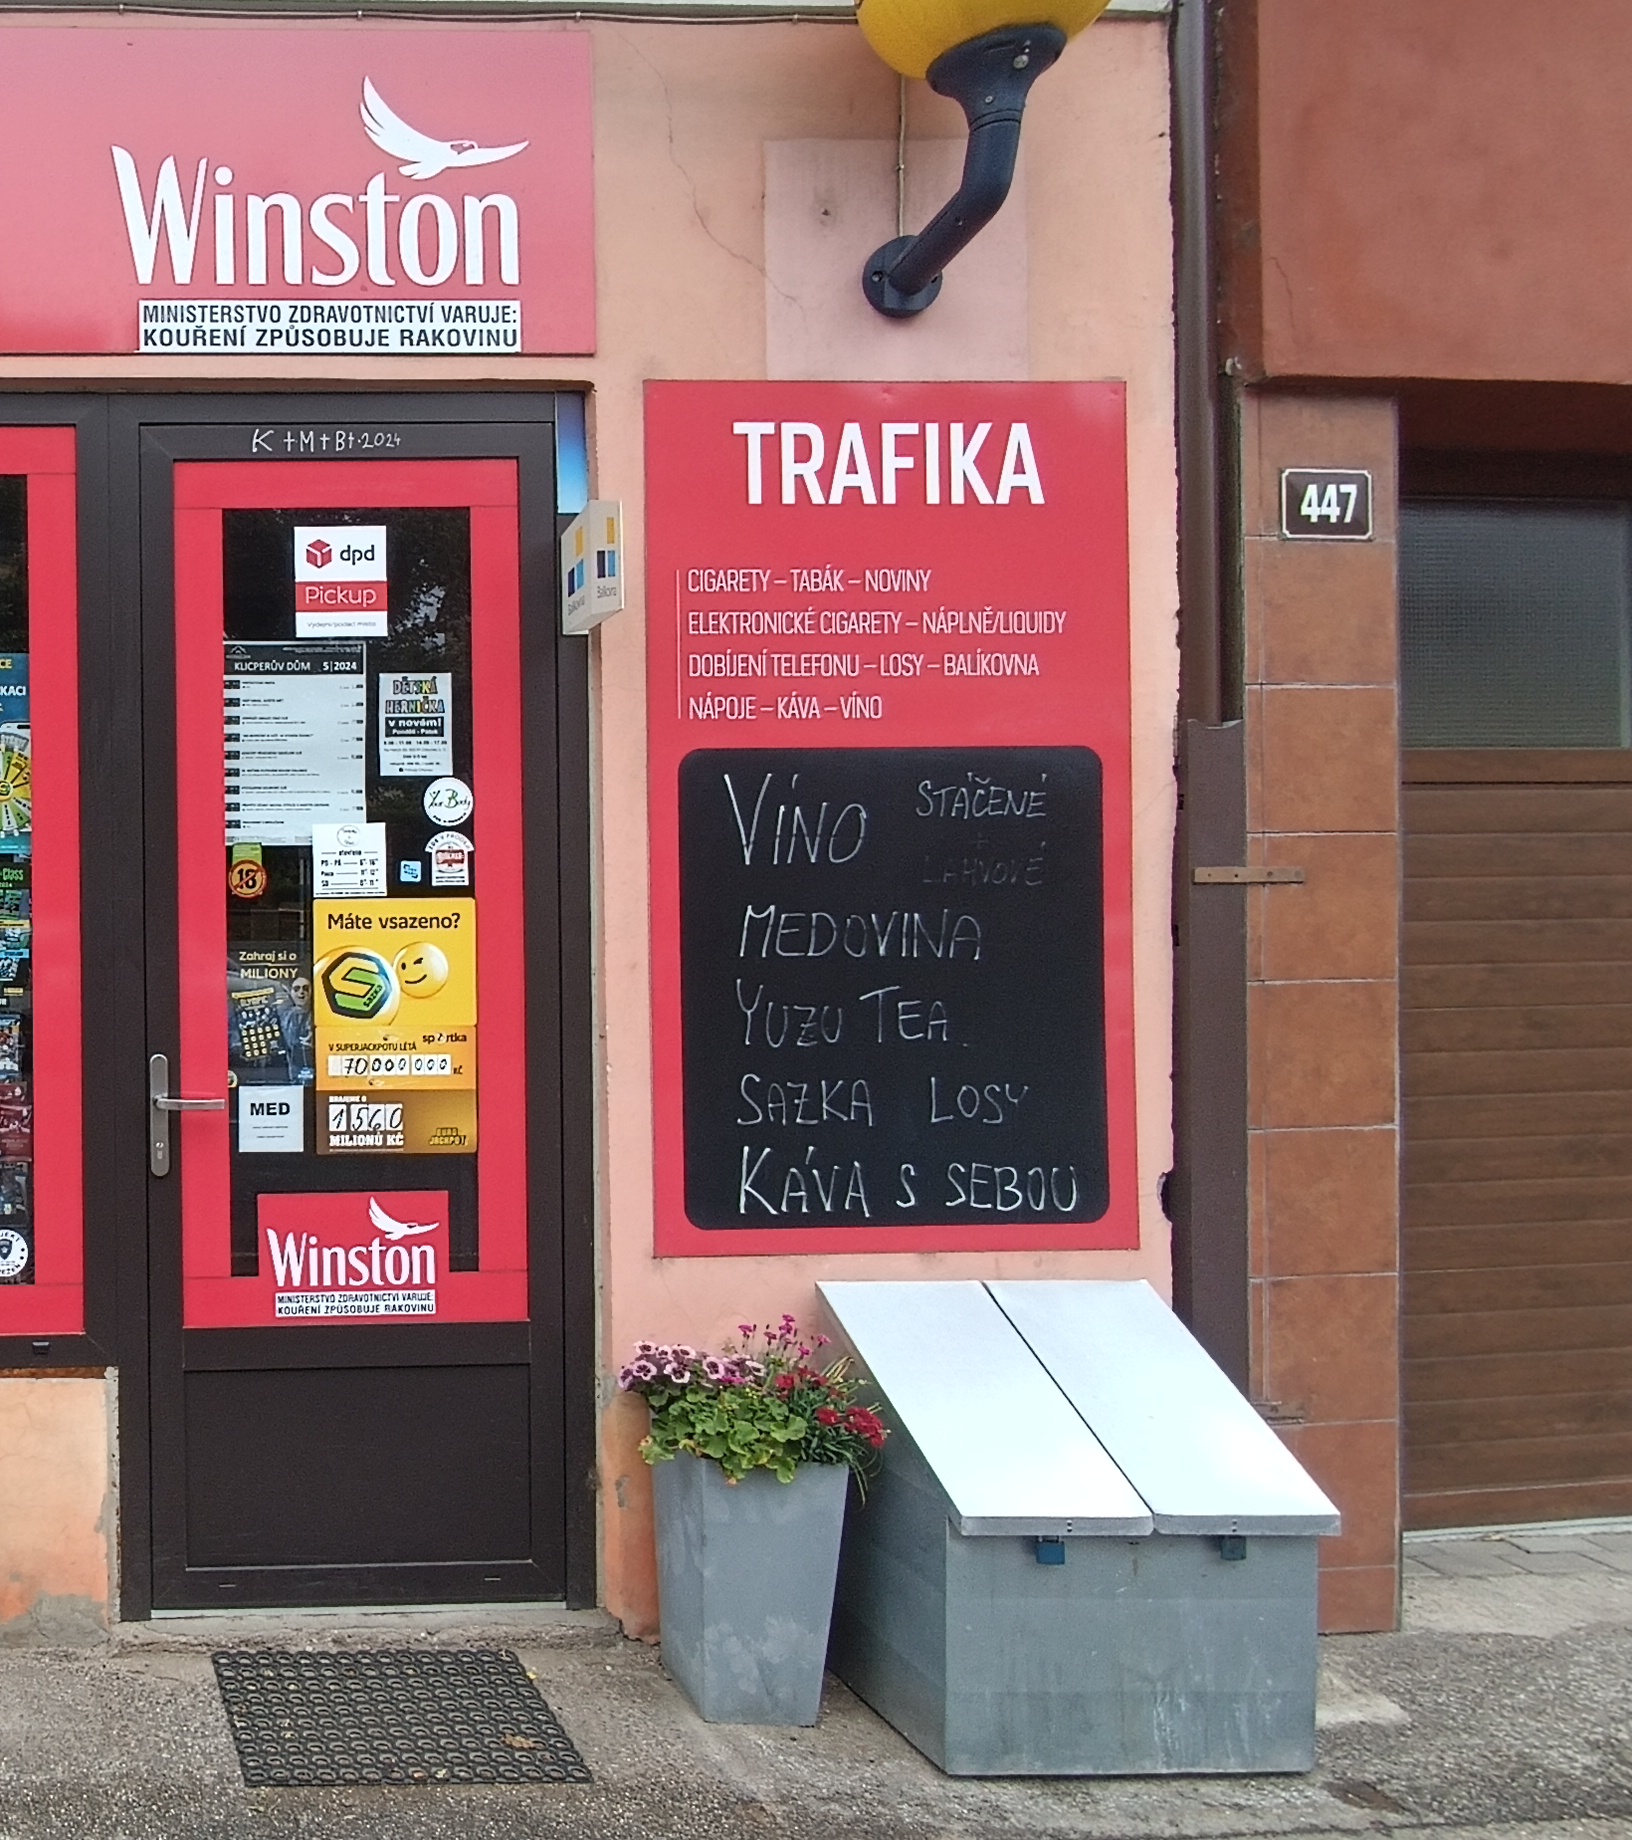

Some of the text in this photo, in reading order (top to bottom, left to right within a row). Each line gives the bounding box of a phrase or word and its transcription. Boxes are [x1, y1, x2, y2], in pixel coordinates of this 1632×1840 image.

[111, 145, 520, 286] Winston
[143, 302, 517, 324] MINISTERSTVO ZDRAVOTNICTVÍ VARUJE:
[143, 324, 517, 348] KOUŘENÍ ZPŮSOBUJE RAKOVINU
[733, 421, 1045, 506] TRAFIKA
[1300, 484, 1358, 524] 447
[340, 545, 375, 565] dpd
[687, 564, 932, 593] CIGARETY TABÁK NOVINY
[305, 585, 377, 609] Pickup
[688, 606, 1067, 635] ELEKTRONICKÉ CIGARETY NÁPLNĚ/LIQUIDY
[286, 659, 311, 671] DŮM
[688, 648, 1039, 677] DOBÍJENÍ TELEFONU LOSY BALÍKOVNA
[688, 690, 883, 719] NÁPOJE KÁVA VÍNO
[724, 772, 1048, 865] VÍNO STAČENÉ
[328, 913, 461, 929] Máte vsazeno?
[739, 904, 982, 961] MEDOVINA
[239, 951, 297, 964] Zahraj si o
[240, 968, 298, 979] MILIONY
[736, 979, 843, 1048] YUZU
[250, 1102, 291, 1116] MED
[737, 1073, 1028, 1126] SAZKA LOSY
[329, 1133, 383, 1147] MILIONŮ
[739, 1146, 1079, 1217] KÁVA S SEBOU
[267, 1228, 435, 1286] Winston
[278, 1292, 434, 1304] MINISTERSTVO ZDRAVOTNICTVÍ VARUJE:
[278, 1303, 434, 1315] KOUŘENÍ ZPŮSOBUJE RAKOVINU
